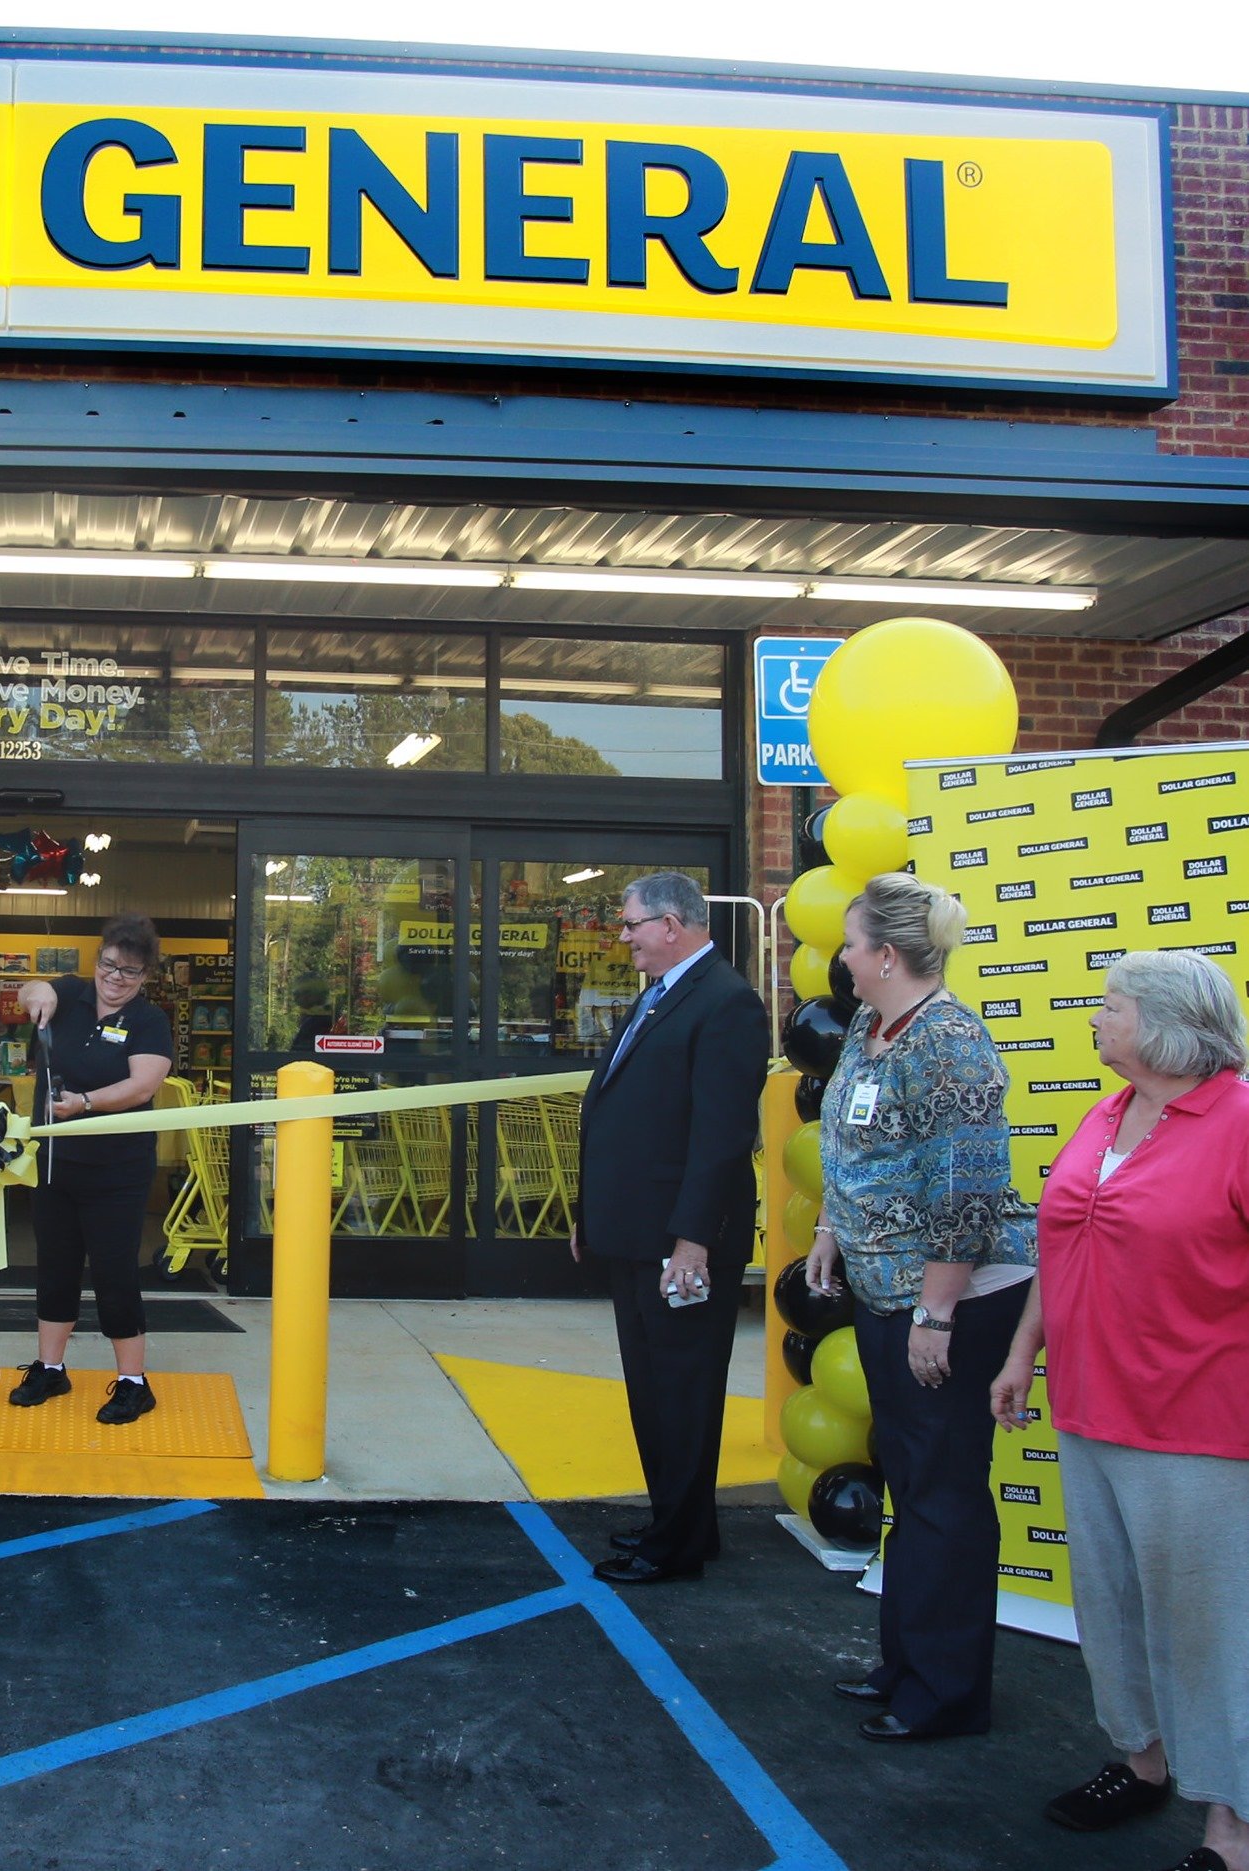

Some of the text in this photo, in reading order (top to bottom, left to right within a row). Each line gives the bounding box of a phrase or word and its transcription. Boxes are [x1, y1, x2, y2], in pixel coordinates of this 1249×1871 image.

[40, 117, 1009, 310] GENERAL
[41, 651, 125, 677] Time.
[41, 679, 146, 709] Money.
[40, 703, 117, 735] Day!
[0, 741, 42, 760] 12253
[761, 743, 818, 766] PARK
[1008, 763, 1038, 773] DOLLAR
[943, 772, 971, 781] DOLLAR
[942, 778, 974, 788] GENERAL
[1162, 776, 1233, 791] DOLLAR GENERAL
[1076, 791, 1107, 801] DOLLAR
[1075, 798, 1109, 808] GENERAL
[969, 807, 1032, 821] DOLLAR GENERAL
[1131, 826, 1162, 835] DOLLAR
[1129, 833, 1165, 843] GENERAL
[1021, 840, 1085, 854] DOLLAR GENERAL
[955, 852, 983, 860] DOLLAR
[953, 858, 985, 867] GENERAL
[1189, 860, 1221, 869] DOLLAR
[1187, 867, 1224, 877] GENERAL
[1073, 874, 1140, 887] DOLLAR GENERAL
[1001, 884, 1030, 893] DOLLAR
[999, 891, 1032, 899] GENERAL
[1153, 906, 1184, 915] DOLLAR
[1151, 913, 1187, 922] GENERAL
[1028, 917, 1113, 933] DOLLAR GENERAL
[407, 927, 539, 942] DOLLA GERAL
[195, 956, 215, 967] DG
[557, 951, 605, 968] IGHT
[982, 963, 1045, 975] DOLLAR GENERAL
[986, 1002, 1015, 1010] DOLLAR
[1053, 999, 1085, 1008] DOLLAR
[985, 1009, 1018, 1017] GENERAL
[177, 1024, 189, 1070] DEALS
[1019, 1041, 1051, 1049] GENERAL
[1032, 1081, 1098, 1091] DOLLAR GENERAL
[1022, 1126, 1054, 1134] GENERAL
[1026, 1452, 1056, 1460] DOLLAR
[1005, 1486, 1035, 1495] DOLLAR
[1004, 1493, 1037, 1502] GENERAL
[1016, 1568, 1049, 1579] GENERAL
